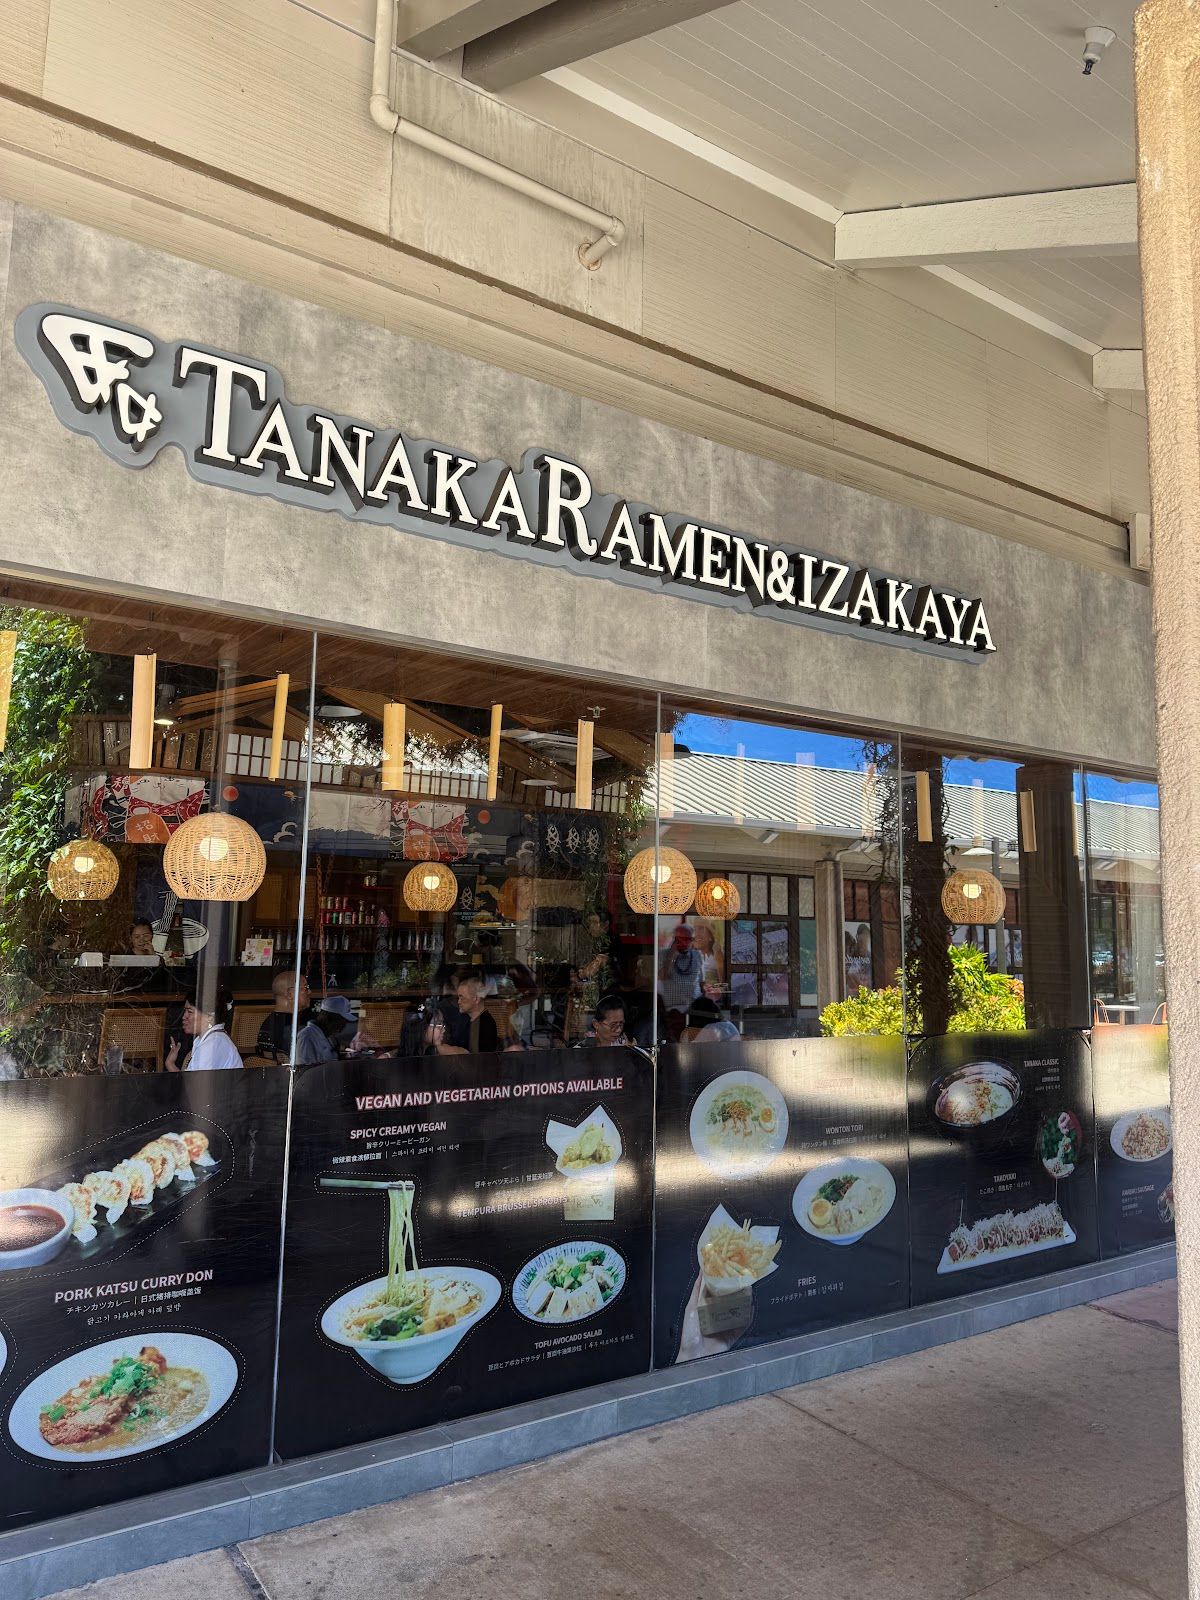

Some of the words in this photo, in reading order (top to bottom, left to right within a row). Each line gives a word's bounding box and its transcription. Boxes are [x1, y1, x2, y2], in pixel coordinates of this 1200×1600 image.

[356, 1094, 402, 1111] VEGAN
[403, 1091, 432, 1107] AND
[435, 1086, 511, 1104] VEGETARIAN
[513, 1081, 564, 1098] OPTIONS
[566, 1077, 624, 1094] AVAILABLE
[350, 1127, 377, 1140] SPICY
[378, 1123, 416, 1137] CREAMY
[417, 1121, 447, 1132] VEGAN
[457, 1206, 496, 1219] TEMPURA
[497, 1201, 532, 1213] BRUSSEL
[533, 1195, 569, 1208] SPROUTS
[54, 1286, 93, 1304] PORK
[95, 1280, 138, 1298] KATSU
[141, 1273, 185, 1290] CURRY
[185, 1269, 214, 1284] DON
[797, 1275, 817, 1287] FRIES
[66, 1300, 131, 1315] チキンカツカレー
[534, 1340, 552, 1350] TOFU
[552, 1333, 583, 1346] AVOCADO
[583, 1329, 603, 1340] SALAD
